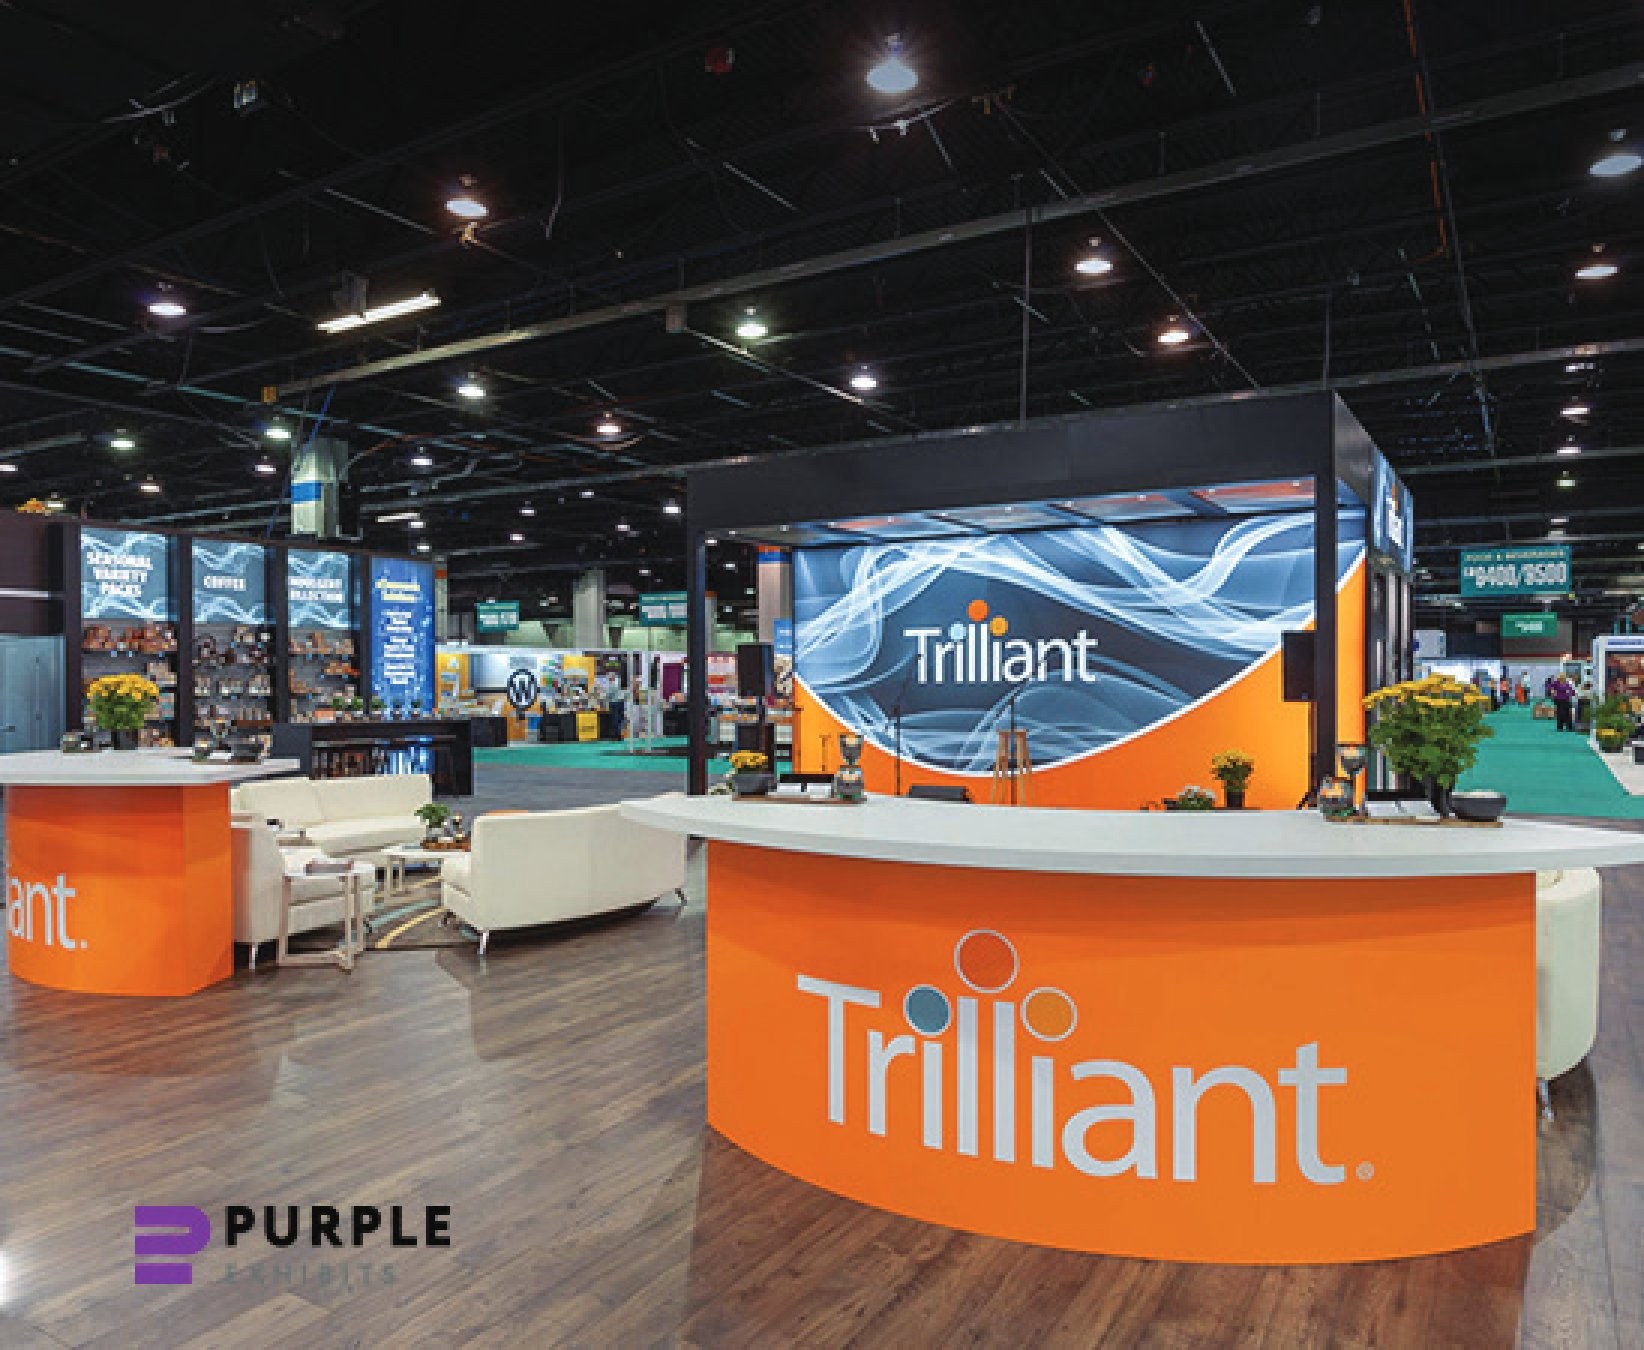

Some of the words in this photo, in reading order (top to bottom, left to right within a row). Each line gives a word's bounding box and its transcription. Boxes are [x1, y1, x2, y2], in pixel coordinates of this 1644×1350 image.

[93, 566, 147, 583] VARIETY
[203, 575, 247, 592] COFFEE
[903, 599, 1099, 684] Trilliant
